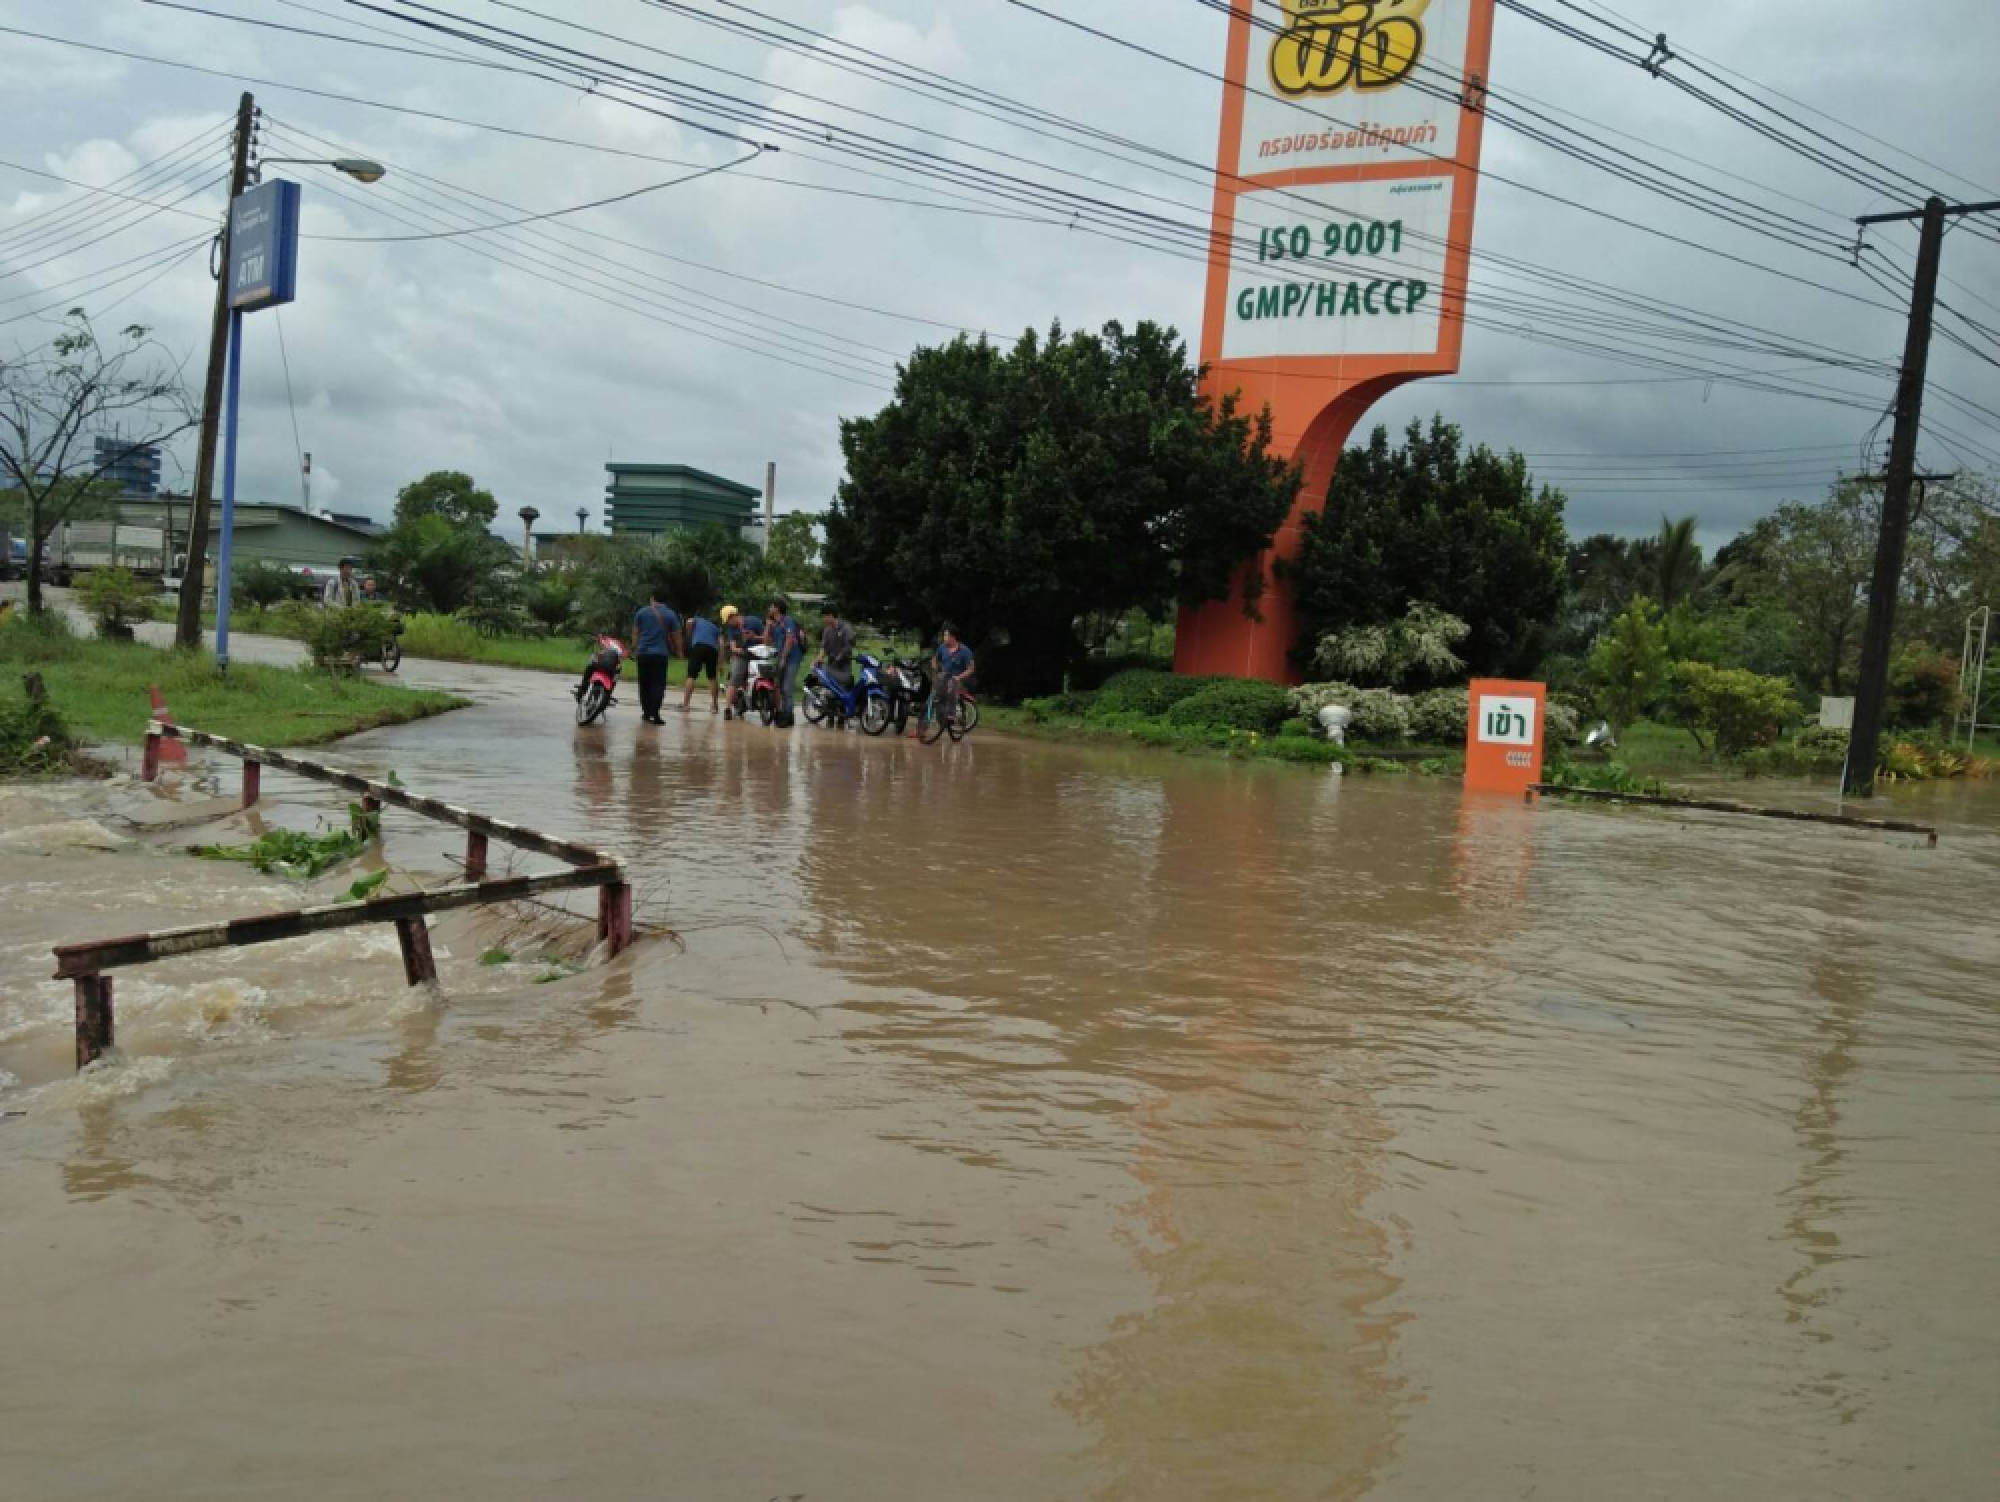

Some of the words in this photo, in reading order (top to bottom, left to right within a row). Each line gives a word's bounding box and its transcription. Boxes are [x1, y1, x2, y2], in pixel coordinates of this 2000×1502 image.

[1259, 224, 1311, 262] ISO
[1323, 219, 1403, 257] 9001
[1236, 279, 1428, 321] GMP/HACCP
[1487, 703, 1527, 739] เข้า
